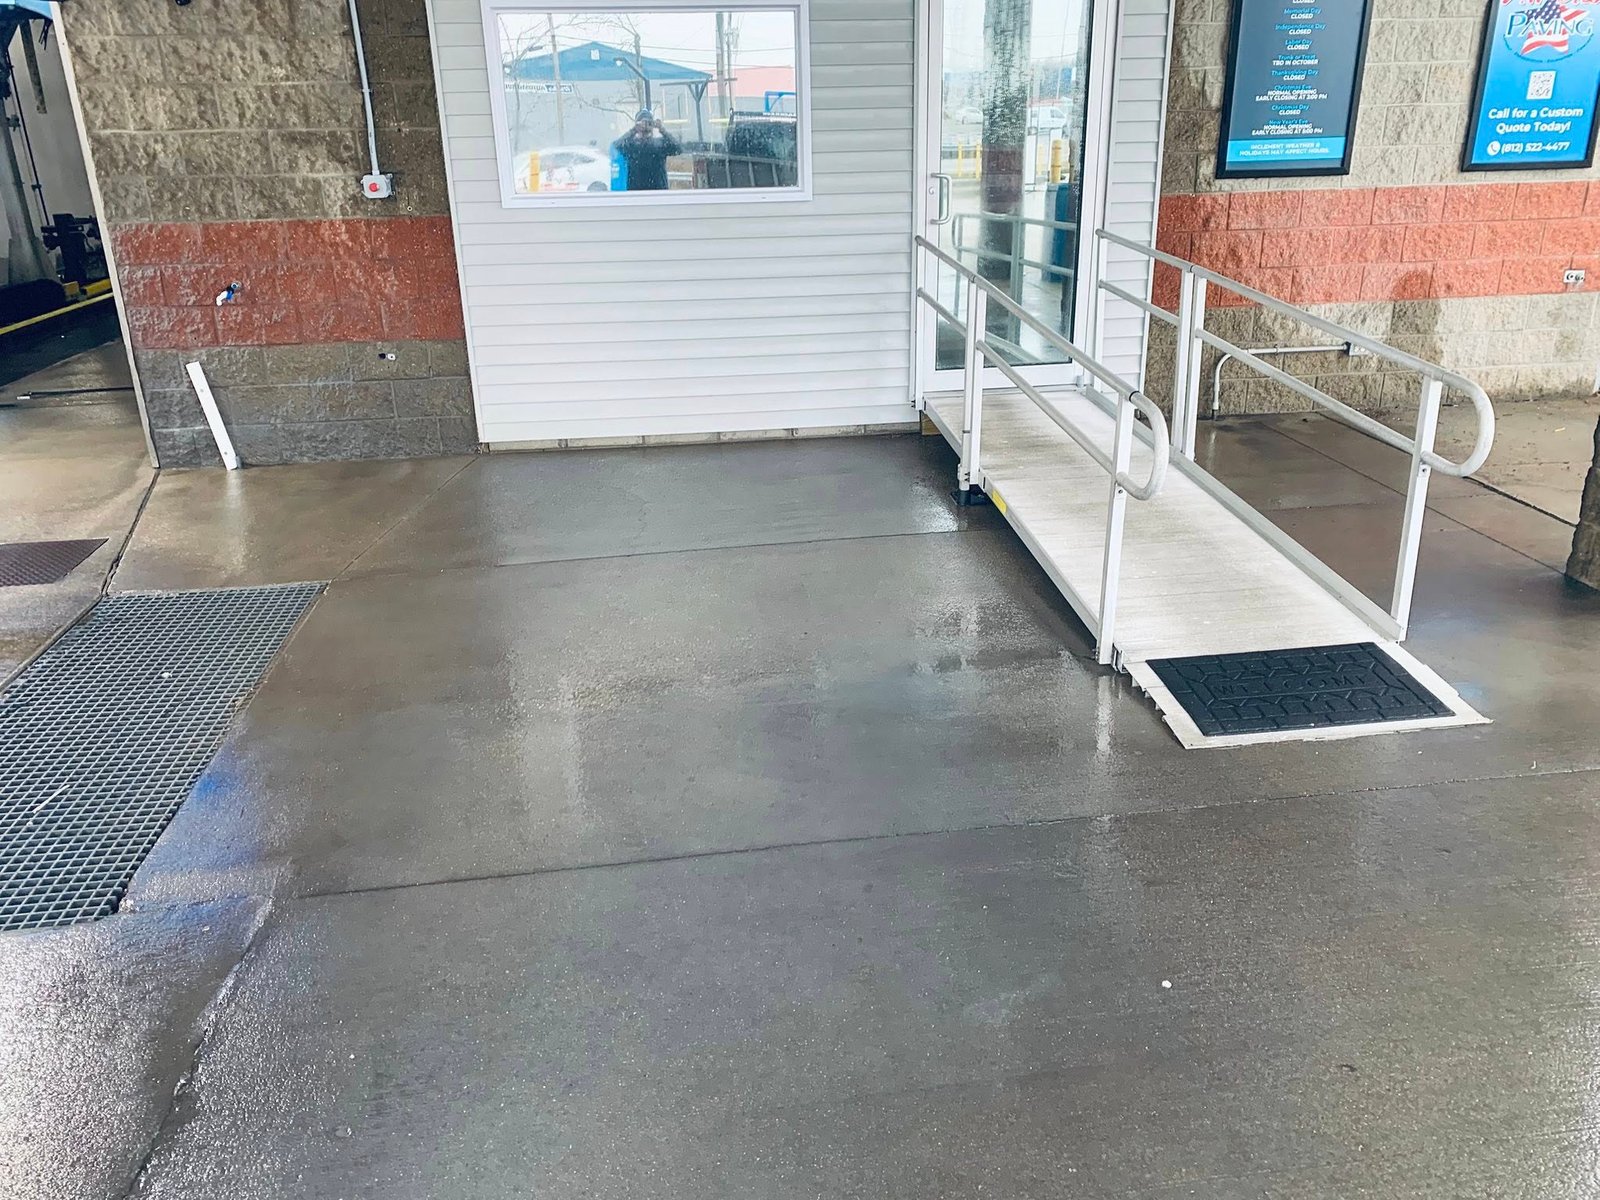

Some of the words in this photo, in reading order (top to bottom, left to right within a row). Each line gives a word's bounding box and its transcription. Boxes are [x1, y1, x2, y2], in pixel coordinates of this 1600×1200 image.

[1505, 13, 1594, 37] PAVING
[1488, 108, 1511, 120] Call
[1511, 107, 1529, 119] for
[1529, 110, 1538, 118] a
[1539, 107, 1584, 118] Custom
[1496, 122, 1532, 135] Quote
[1533, 121, 1572, 134] Today!
[1239, 149, 1270, 157] HOLIDAYS
[1500, 142, 1524, 155] (812)
[1525, 141, 1571, 153] 522-4477
